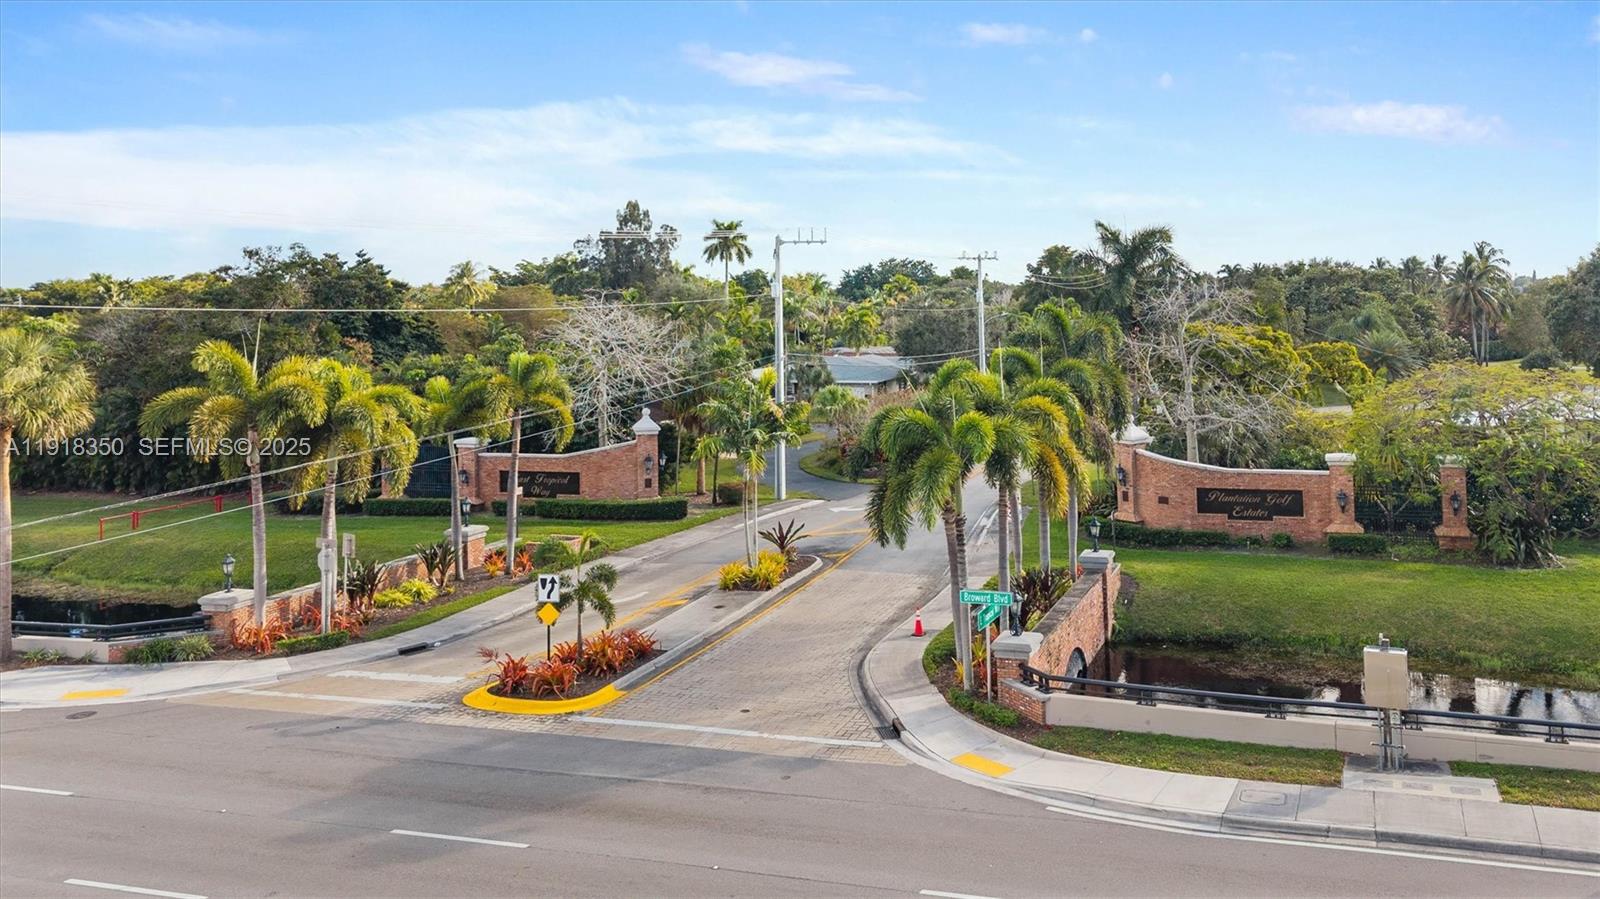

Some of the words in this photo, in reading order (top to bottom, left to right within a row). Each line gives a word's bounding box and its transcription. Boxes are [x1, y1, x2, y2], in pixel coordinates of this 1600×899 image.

[1206, 490, 1261, 503] Plantation
[1266, 493, 1296, 506] Golf
[1232, 505, 1269, 517] Estates
[963, 592, 991, 603] Broward
[993, 593, 1009, 604] Blvd
